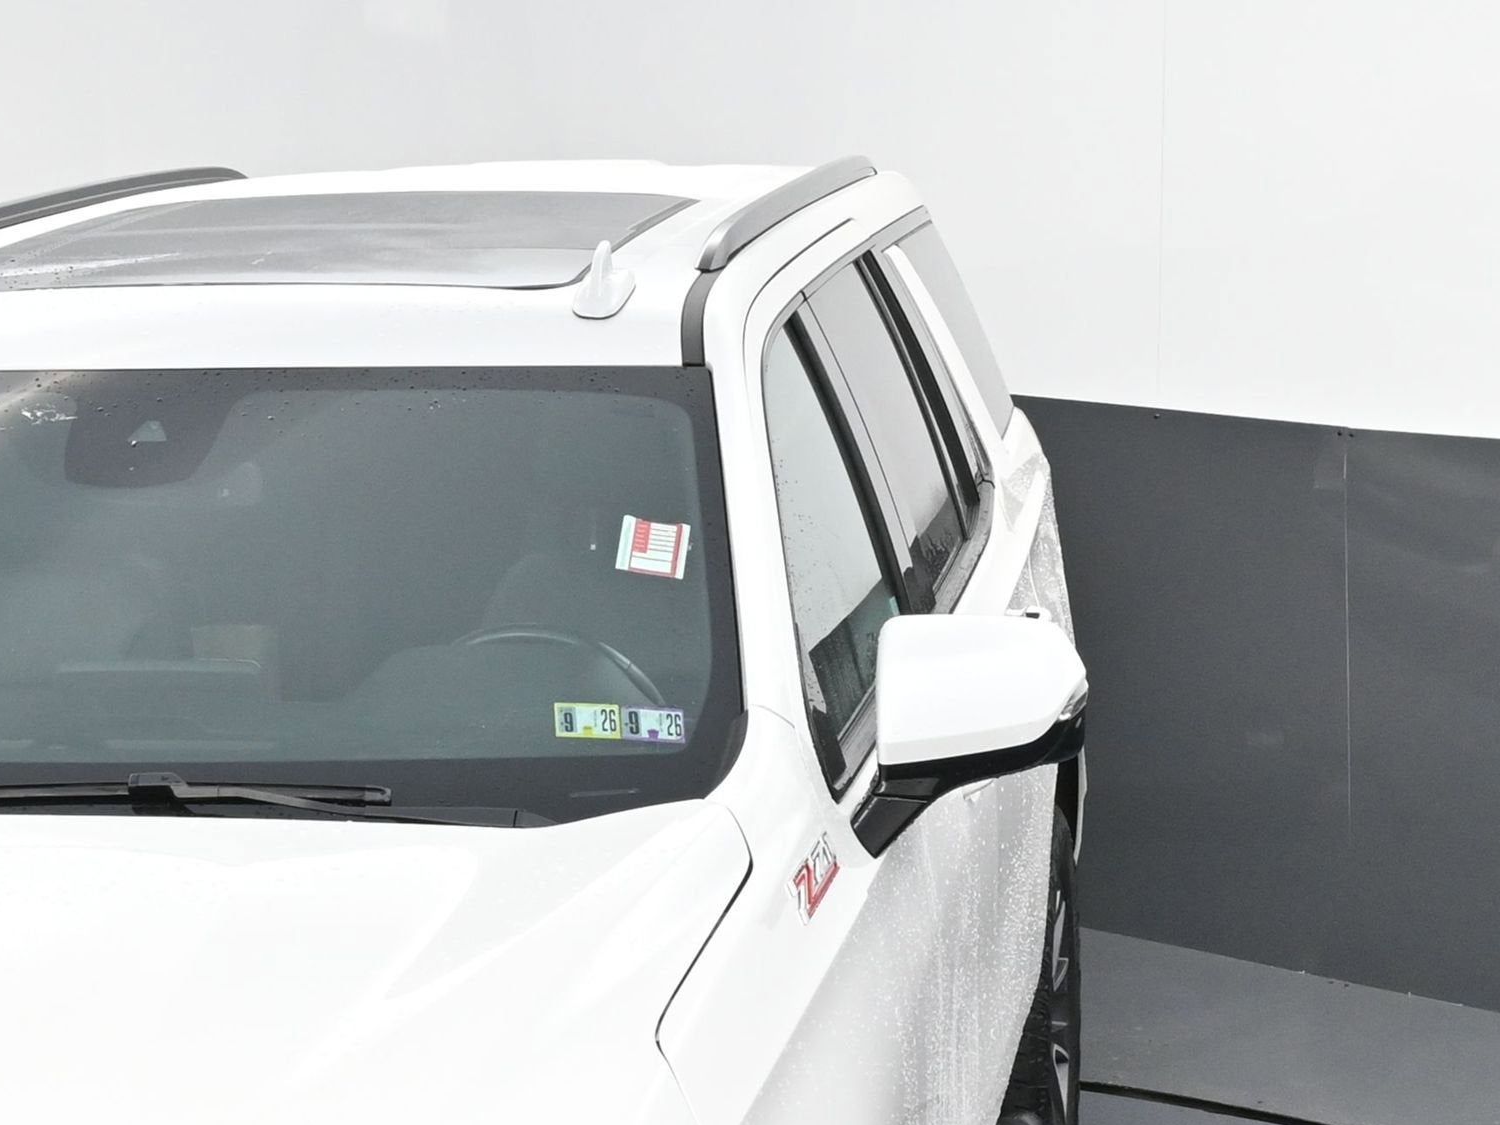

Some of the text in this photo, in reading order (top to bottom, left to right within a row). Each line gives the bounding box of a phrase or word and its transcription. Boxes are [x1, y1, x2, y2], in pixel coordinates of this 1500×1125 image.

[563, 712, 574, 732] 9
[600, 709, 617, 732] 26
[628, 711, 640, 735] 9
[666, 713, 682, 737] 26
[789, 831, 841, 922] Z71
